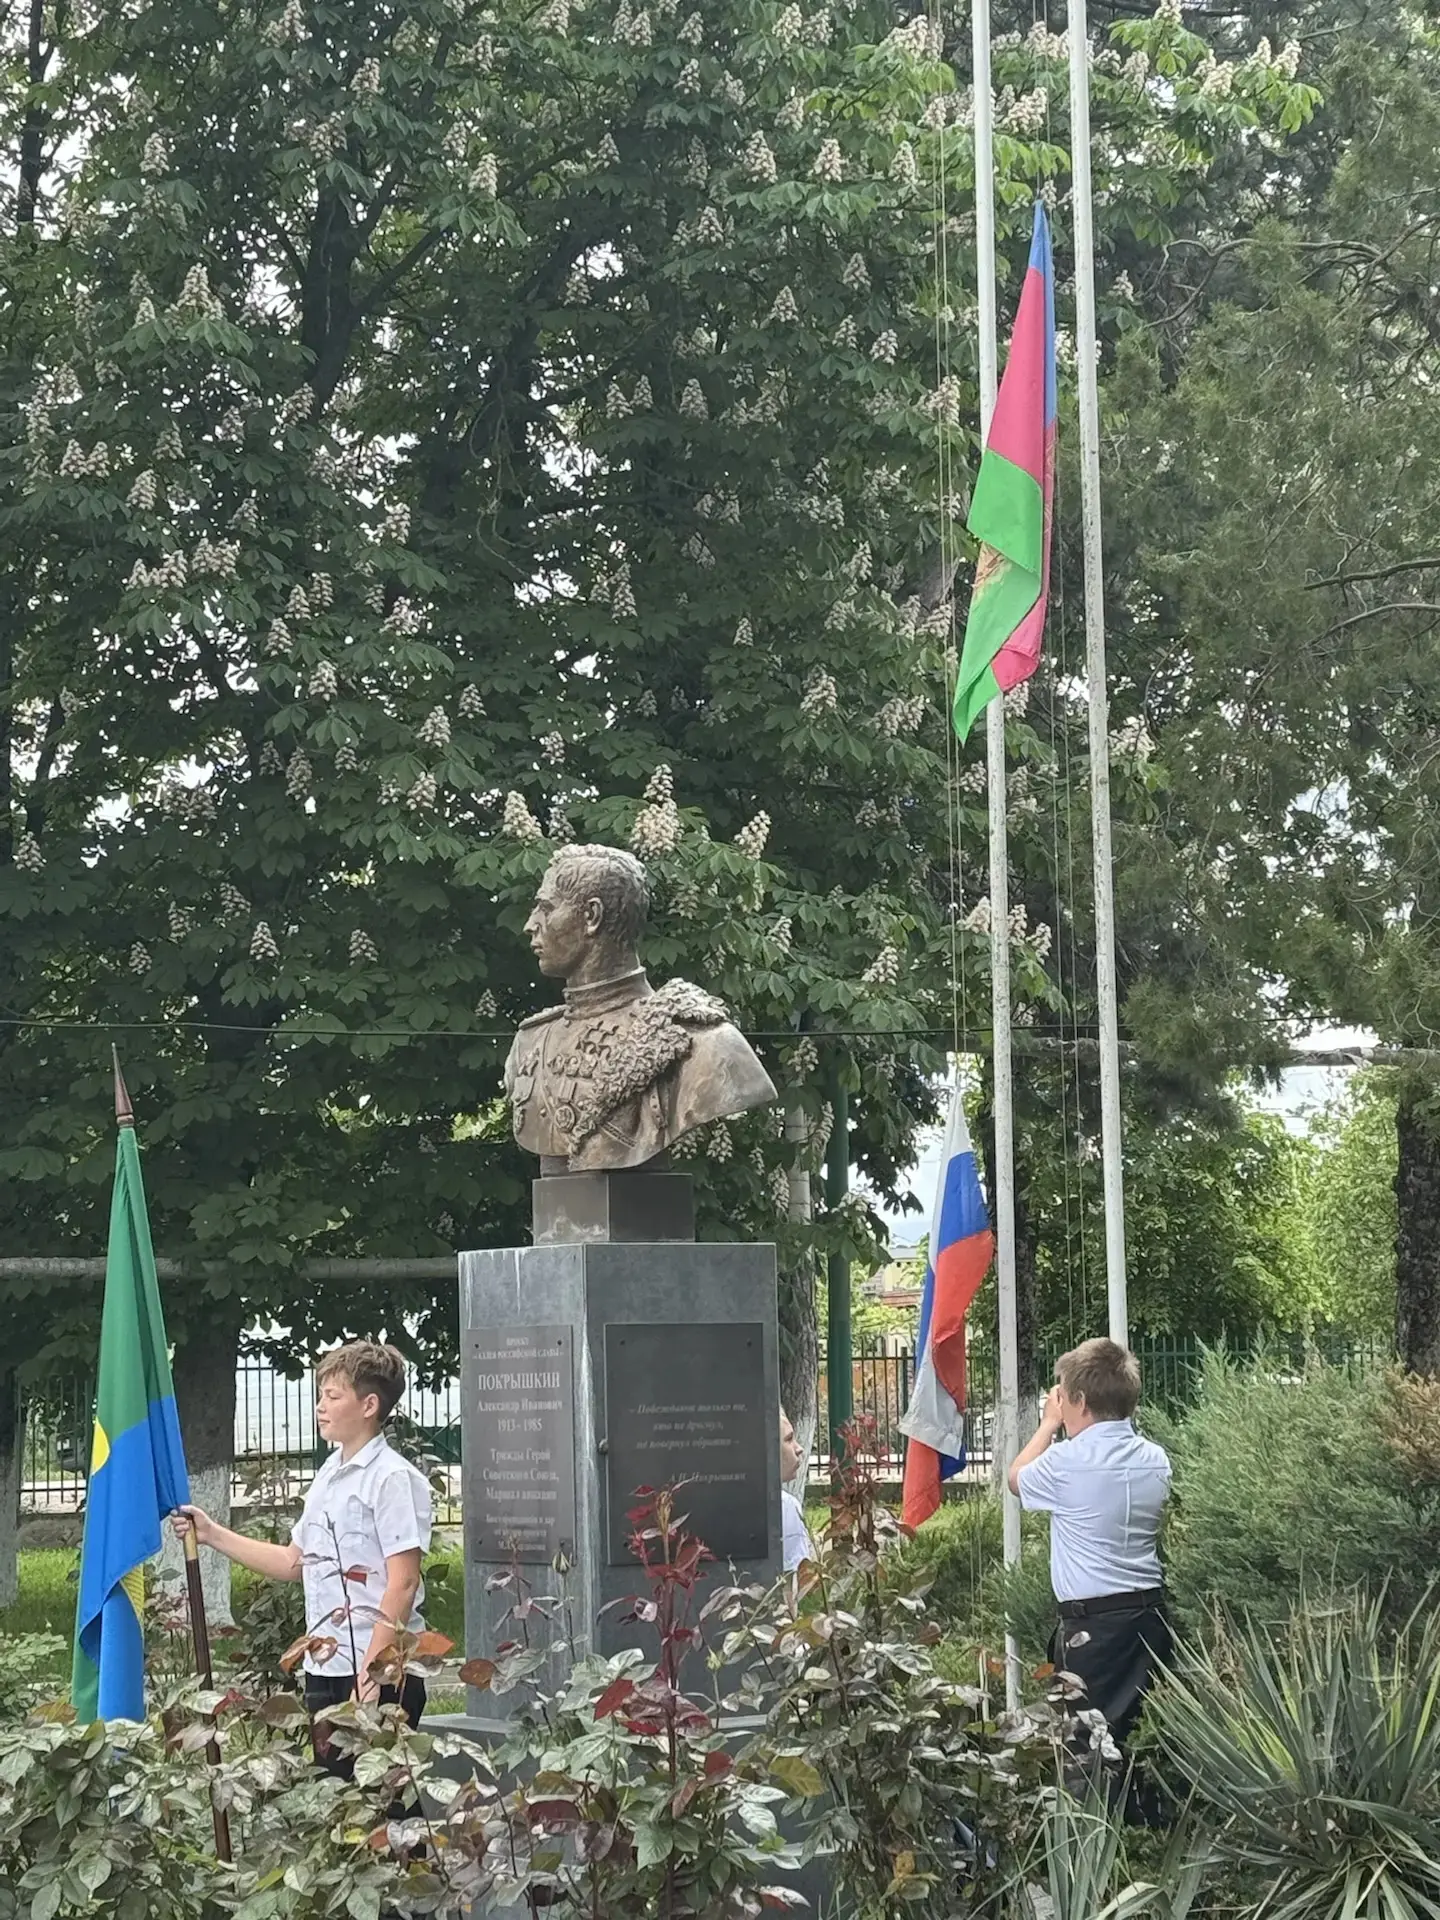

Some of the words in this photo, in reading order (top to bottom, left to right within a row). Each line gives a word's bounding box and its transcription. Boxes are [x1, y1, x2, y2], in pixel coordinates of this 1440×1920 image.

[478, 1371, 560, 1390] ПОКРЫШКИН
[477, 1400, 520, 1414] Александр
[521, 1398, 563, 1411] Иванович
[526, 1447, 551, 1464] Герой
[483, 1468, 528, 1481] Советского
[485, 1487, 520, 1503] Маршал
